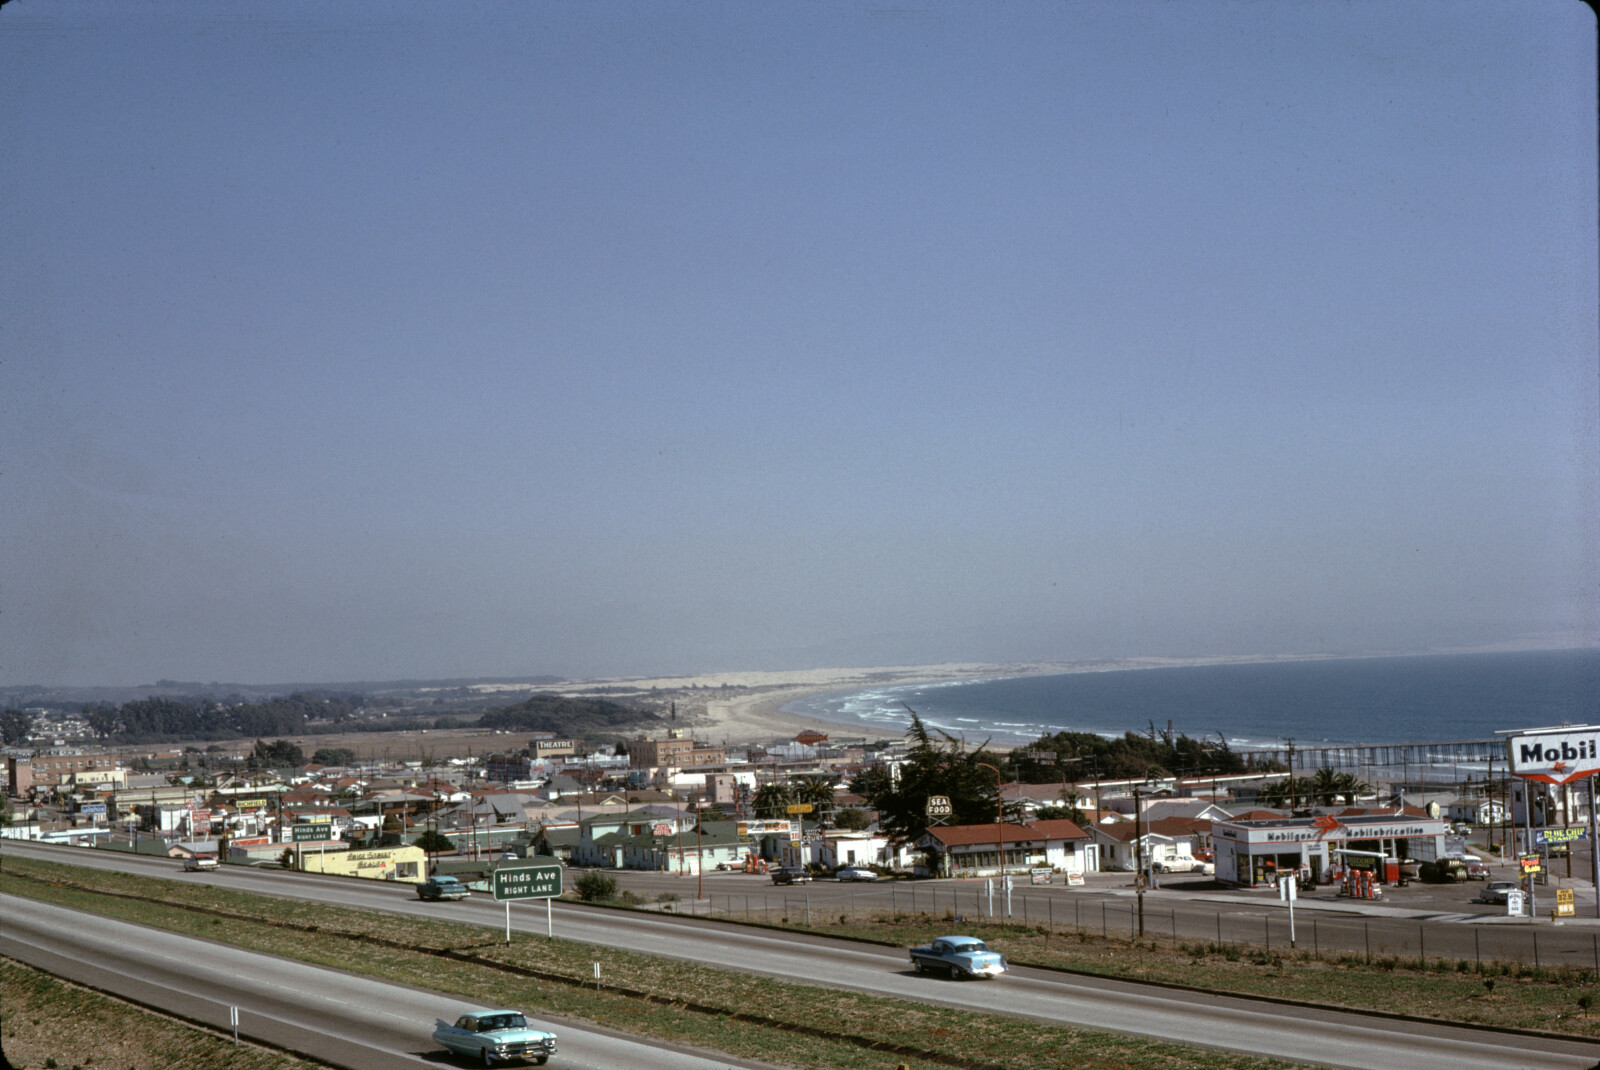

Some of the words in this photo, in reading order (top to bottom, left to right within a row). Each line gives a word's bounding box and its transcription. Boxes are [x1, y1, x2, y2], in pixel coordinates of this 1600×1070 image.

[540, 741, 572, 749] THEATRE
[1520, 740, 1597, 763] Mobil
[931, 798, 947, 806] SEA
[928, 806, 950, 814] FOOD
[1267, 831, 1312, 841] Mobilgas
[1346, 826, 1424, 837] Mobilubrication
[1544, 829, 1564, 839] BLUE
[1565, 827, 1585, 836] CHIP
[1521, 858, 1540, 867] Travel
[500, 872, 531, 883] Hinds
[536, 871, 556, 881] Ave
[504, 885, 528, 895] RIGHT
[531, 884, 553, 893] LANE
